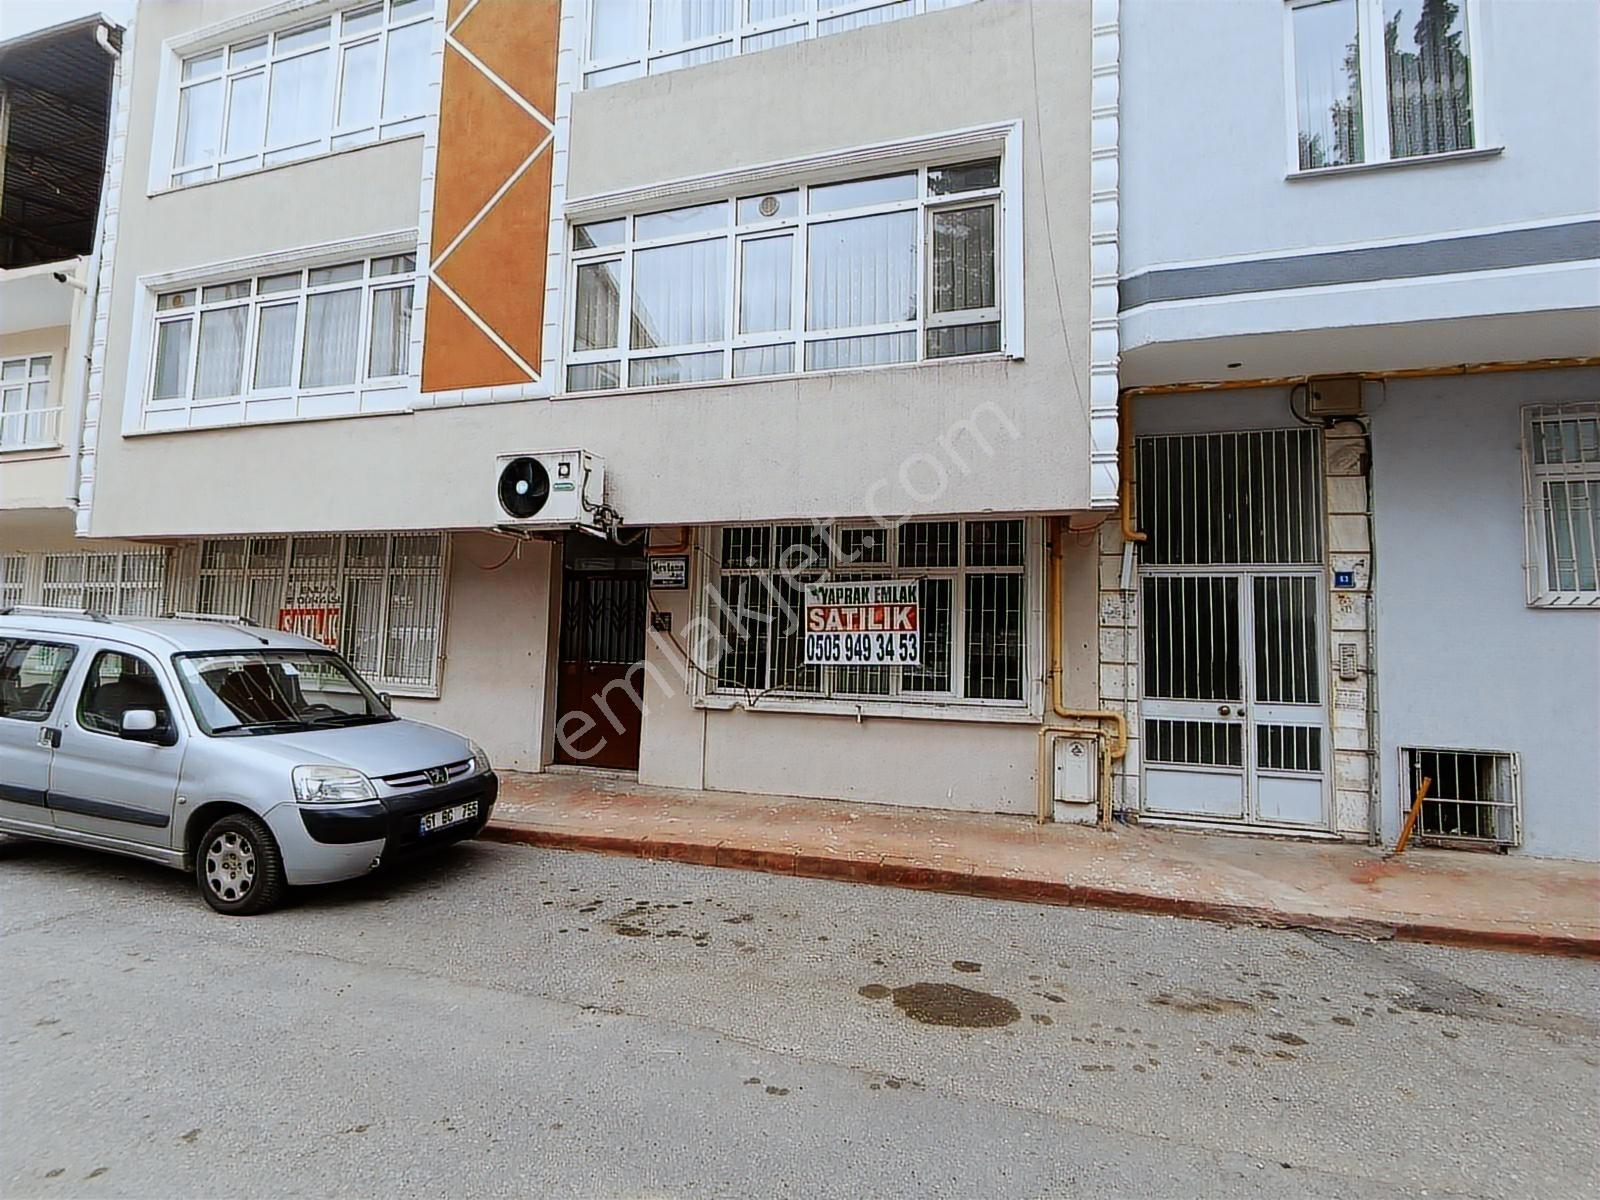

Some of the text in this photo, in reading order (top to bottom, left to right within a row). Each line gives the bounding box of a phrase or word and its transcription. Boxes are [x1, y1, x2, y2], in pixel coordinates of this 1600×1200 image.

[820, 585, 917, 605] YAPRAK EMLAK
[809, 607, 913, 631] SATILIK
[806, 633, 918, 662] 0505 949 34 53
